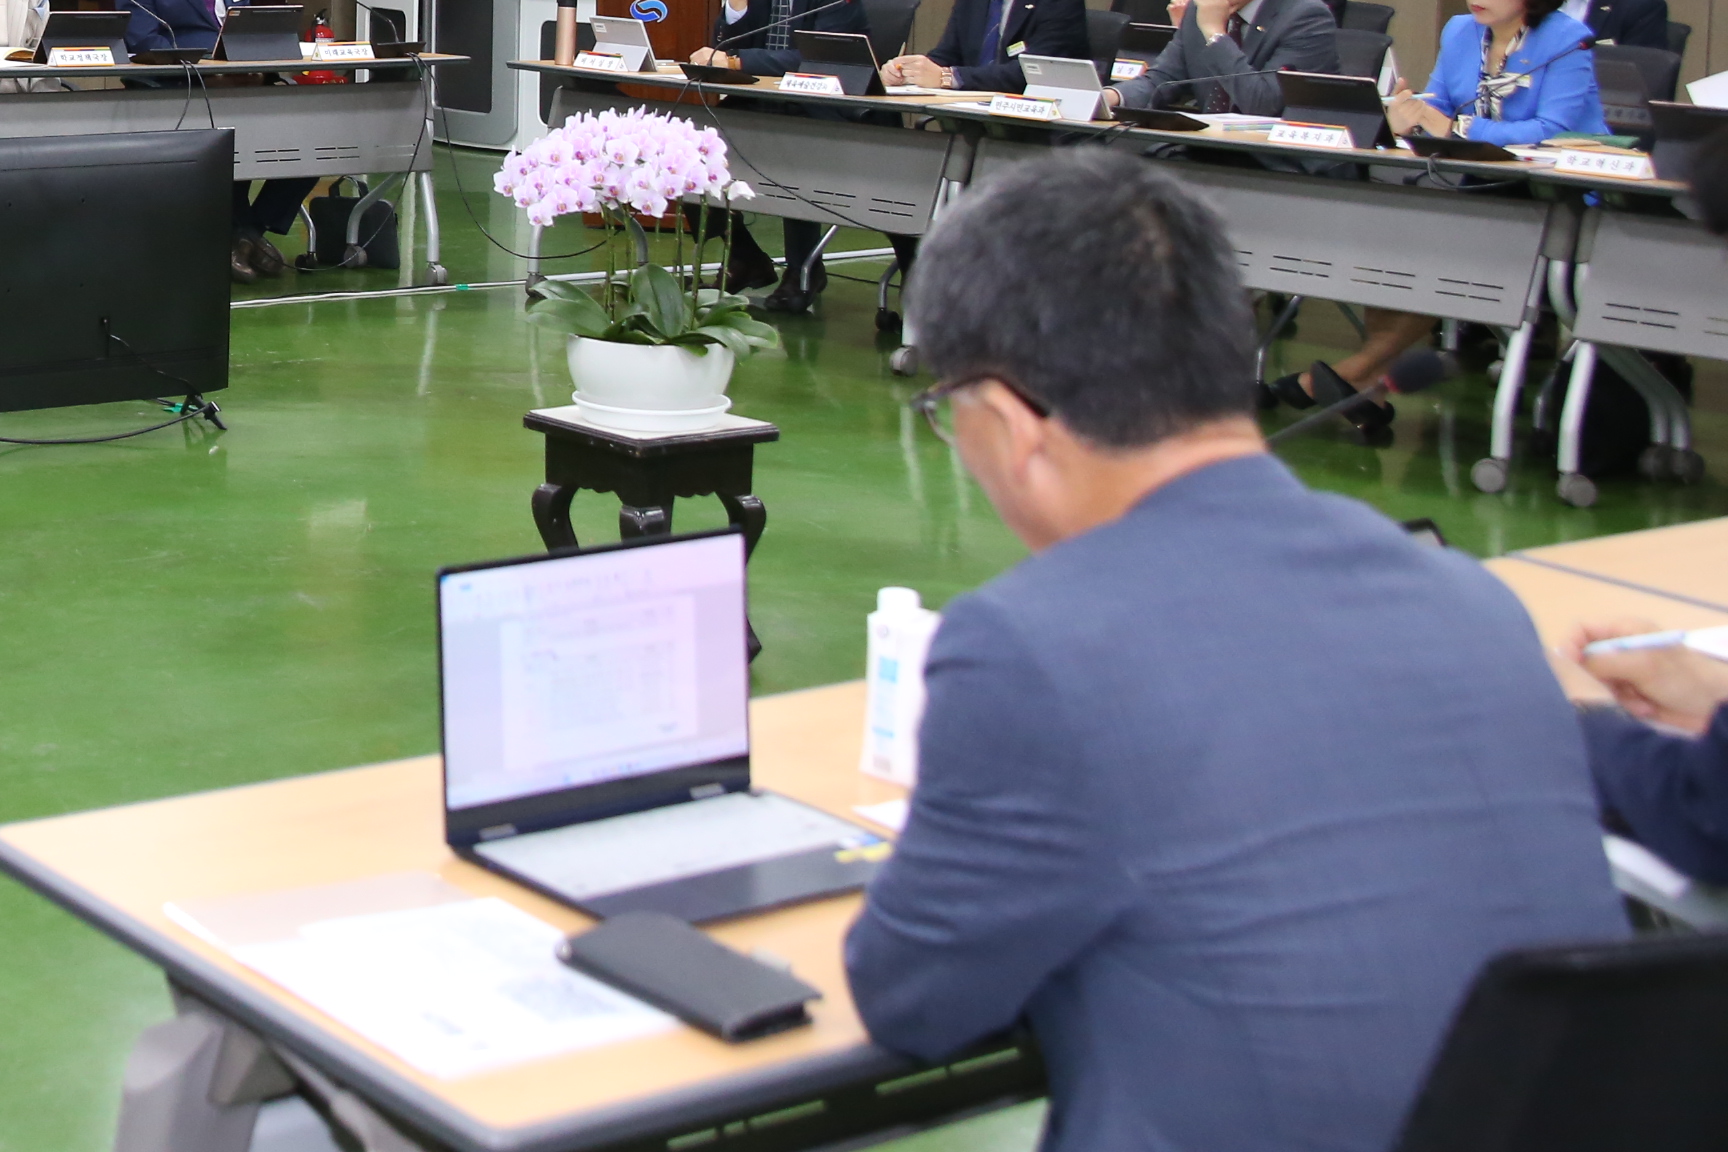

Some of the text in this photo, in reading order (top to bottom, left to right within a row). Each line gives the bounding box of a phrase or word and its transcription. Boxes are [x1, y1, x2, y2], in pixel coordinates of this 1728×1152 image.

[324, 48, 368, 56] 미래교육국장
[60, 53, 108, 62] 학교정책국장
[995, 101, 1045, 114] 민주시민교육과
